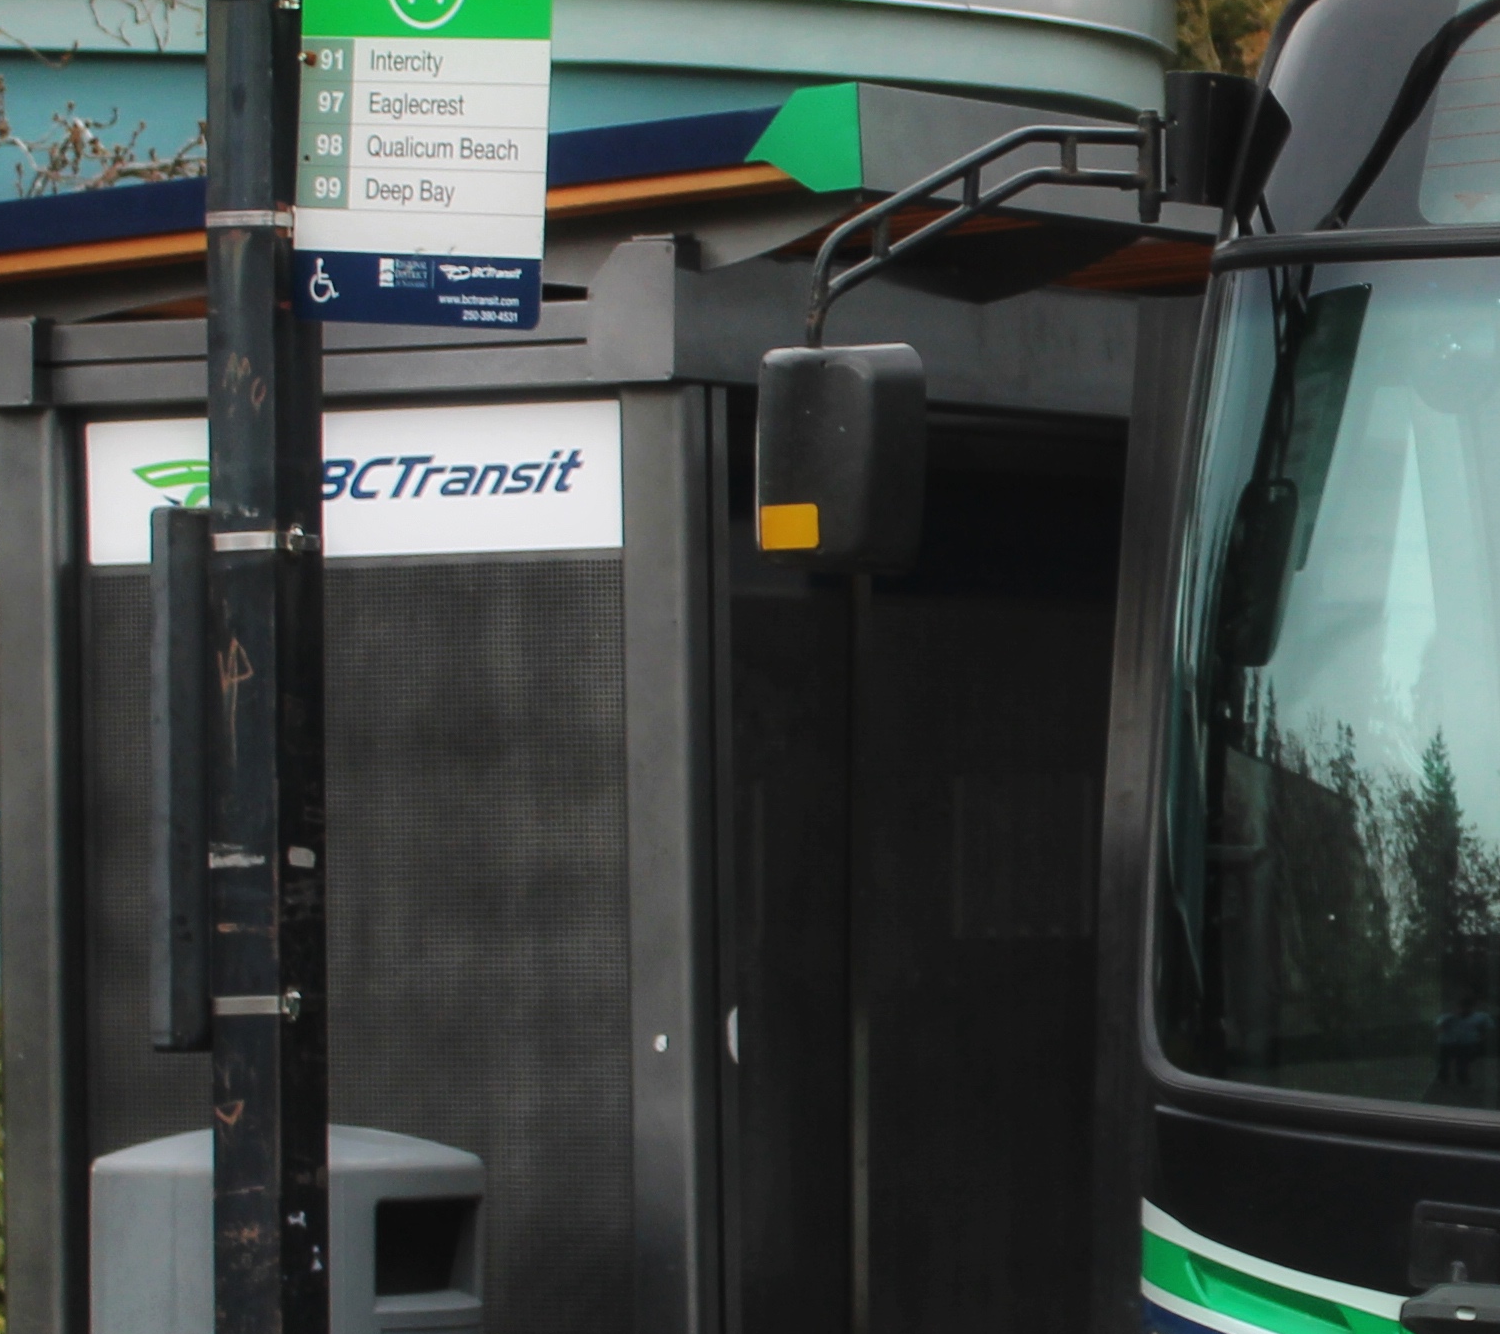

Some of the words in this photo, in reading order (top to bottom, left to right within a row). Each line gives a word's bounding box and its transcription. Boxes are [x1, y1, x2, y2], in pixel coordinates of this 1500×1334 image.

[320, 48, 344, 70] 91
[369, 49, 444, 77] Intercity
[317, 90, 345, 113] 97
[368, 91, 465, 119] Eaglecrest
[316, 133, 344, 156] 98
[366, 134, 454, 160] Qualicum
[460, 138, 519, 161] Beach
[314, 176, 342, 199] 99
[365, 177, 414, 205] Deep
[419, 179, 456, 207] Bay
